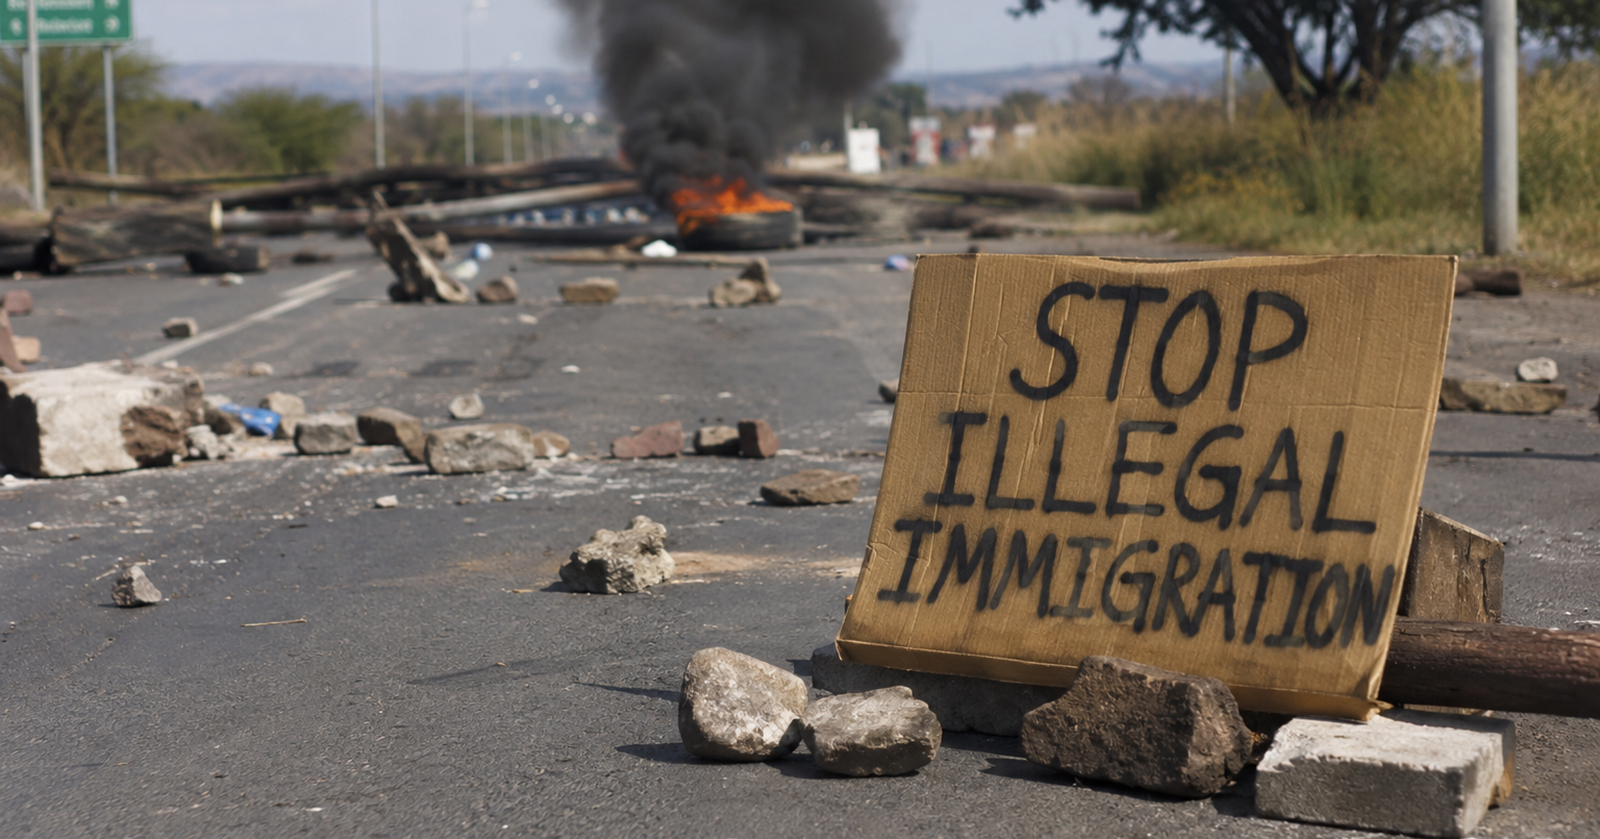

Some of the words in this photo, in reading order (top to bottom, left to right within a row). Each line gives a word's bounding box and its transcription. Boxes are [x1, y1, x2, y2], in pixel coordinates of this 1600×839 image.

[1009, 281, 1309, 412] STOP
[922, 411, 1377, 534] ILLEGAL
[877, 519, 1396, 649] IMMIGRATION
